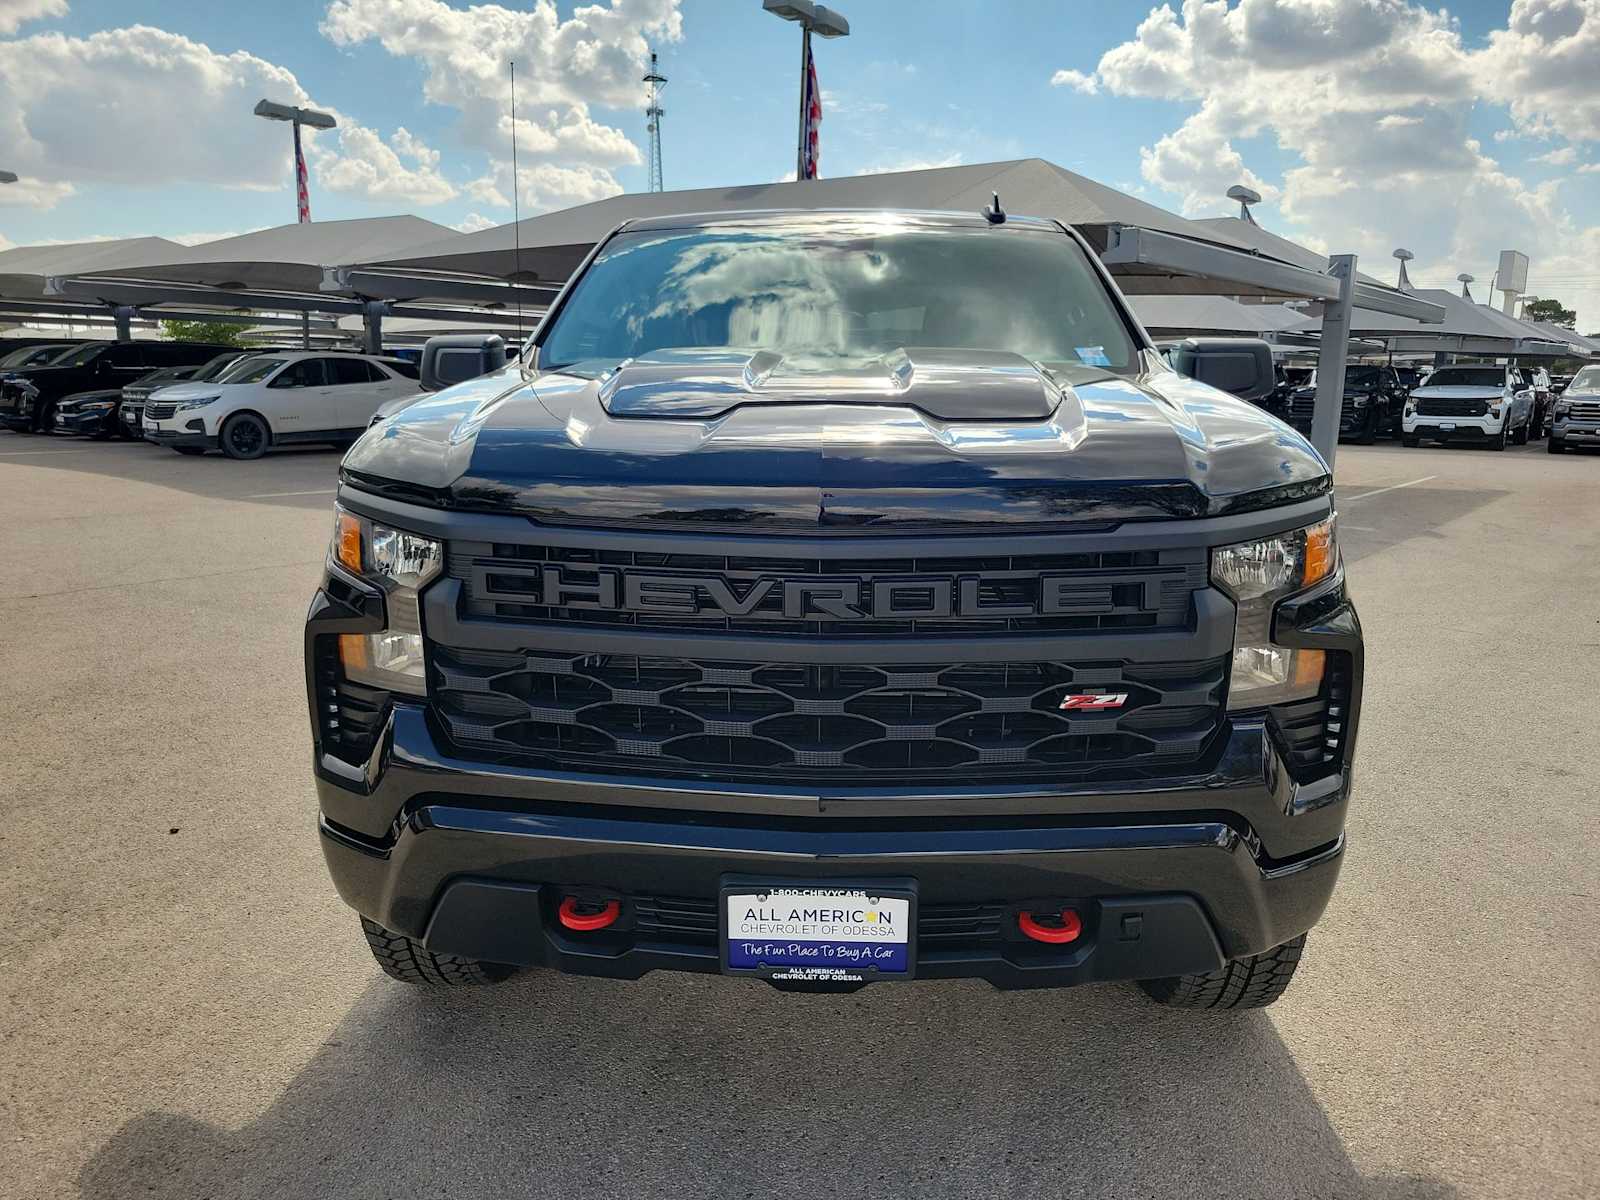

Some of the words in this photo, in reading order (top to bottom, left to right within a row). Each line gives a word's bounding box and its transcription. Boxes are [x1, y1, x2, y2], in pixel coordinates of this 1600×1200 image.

[472, 558, 1187, 617] CHEVROLET
[1059, 694, 1128, 709] Z71
[769, 889, 867, 898] 1-800-CHEVYCARS
[744, 908, 781, 921] ALL
[788, 909, 891, 924] AMERICN
[740, 923, 818, 934] CHEVROLET
[821, 925, 838, 935] OF
[842, 926, 896, 936] ODESSA
[741, 943, 763, 955] The
[764, 944, 786, 955] Fun
[787, 943, 819, 956] Place
[820, 945, 835, 957] To
[836, 946, 860, 961] Buy
[861, 947, 872, 958] A
[874, 947, 894, 958] Car
